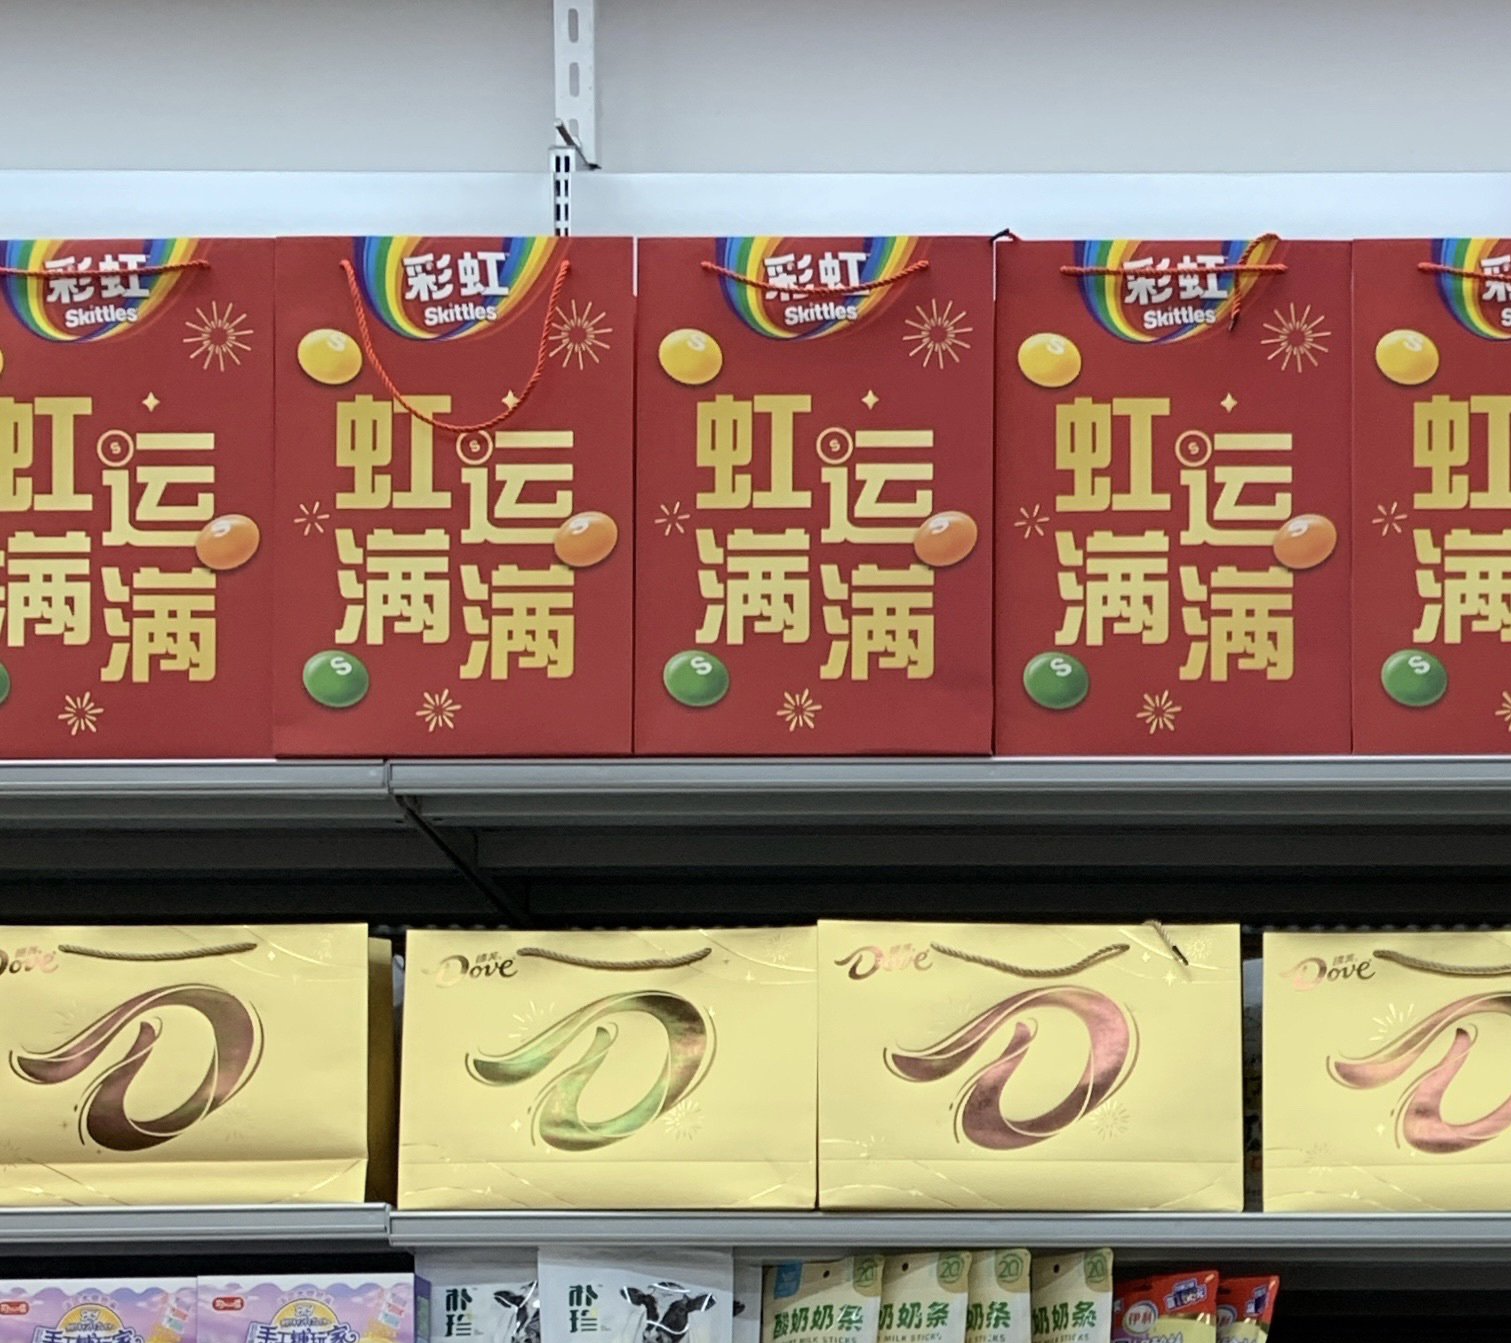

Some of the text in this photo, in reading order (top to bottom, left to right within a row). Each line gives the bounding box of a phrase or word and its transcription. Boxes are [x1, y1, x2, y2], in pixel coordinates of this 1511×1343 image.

[45, 252, 150, 303] 彩虹
[403, 250, 509, 301] 彩虹
[764, 251, 870, 302] 彩虹
[1124, 254, 1228, 305] 彩虹
[65, 304, 138, 329] Skittles
[424, 302, 498, 326] Skittles
[784, 302, 858, 325] Skittles
[1143, 304, 1216, 329] Skittles
[0, 951, 59, 975] ove
[434, 954, 519, 989] Dove
[834, 945, 933, 981] Dove
[1280, 957, 1377, 992] Dove
[774, 1304, 863, 1339] 酸奶奶条
